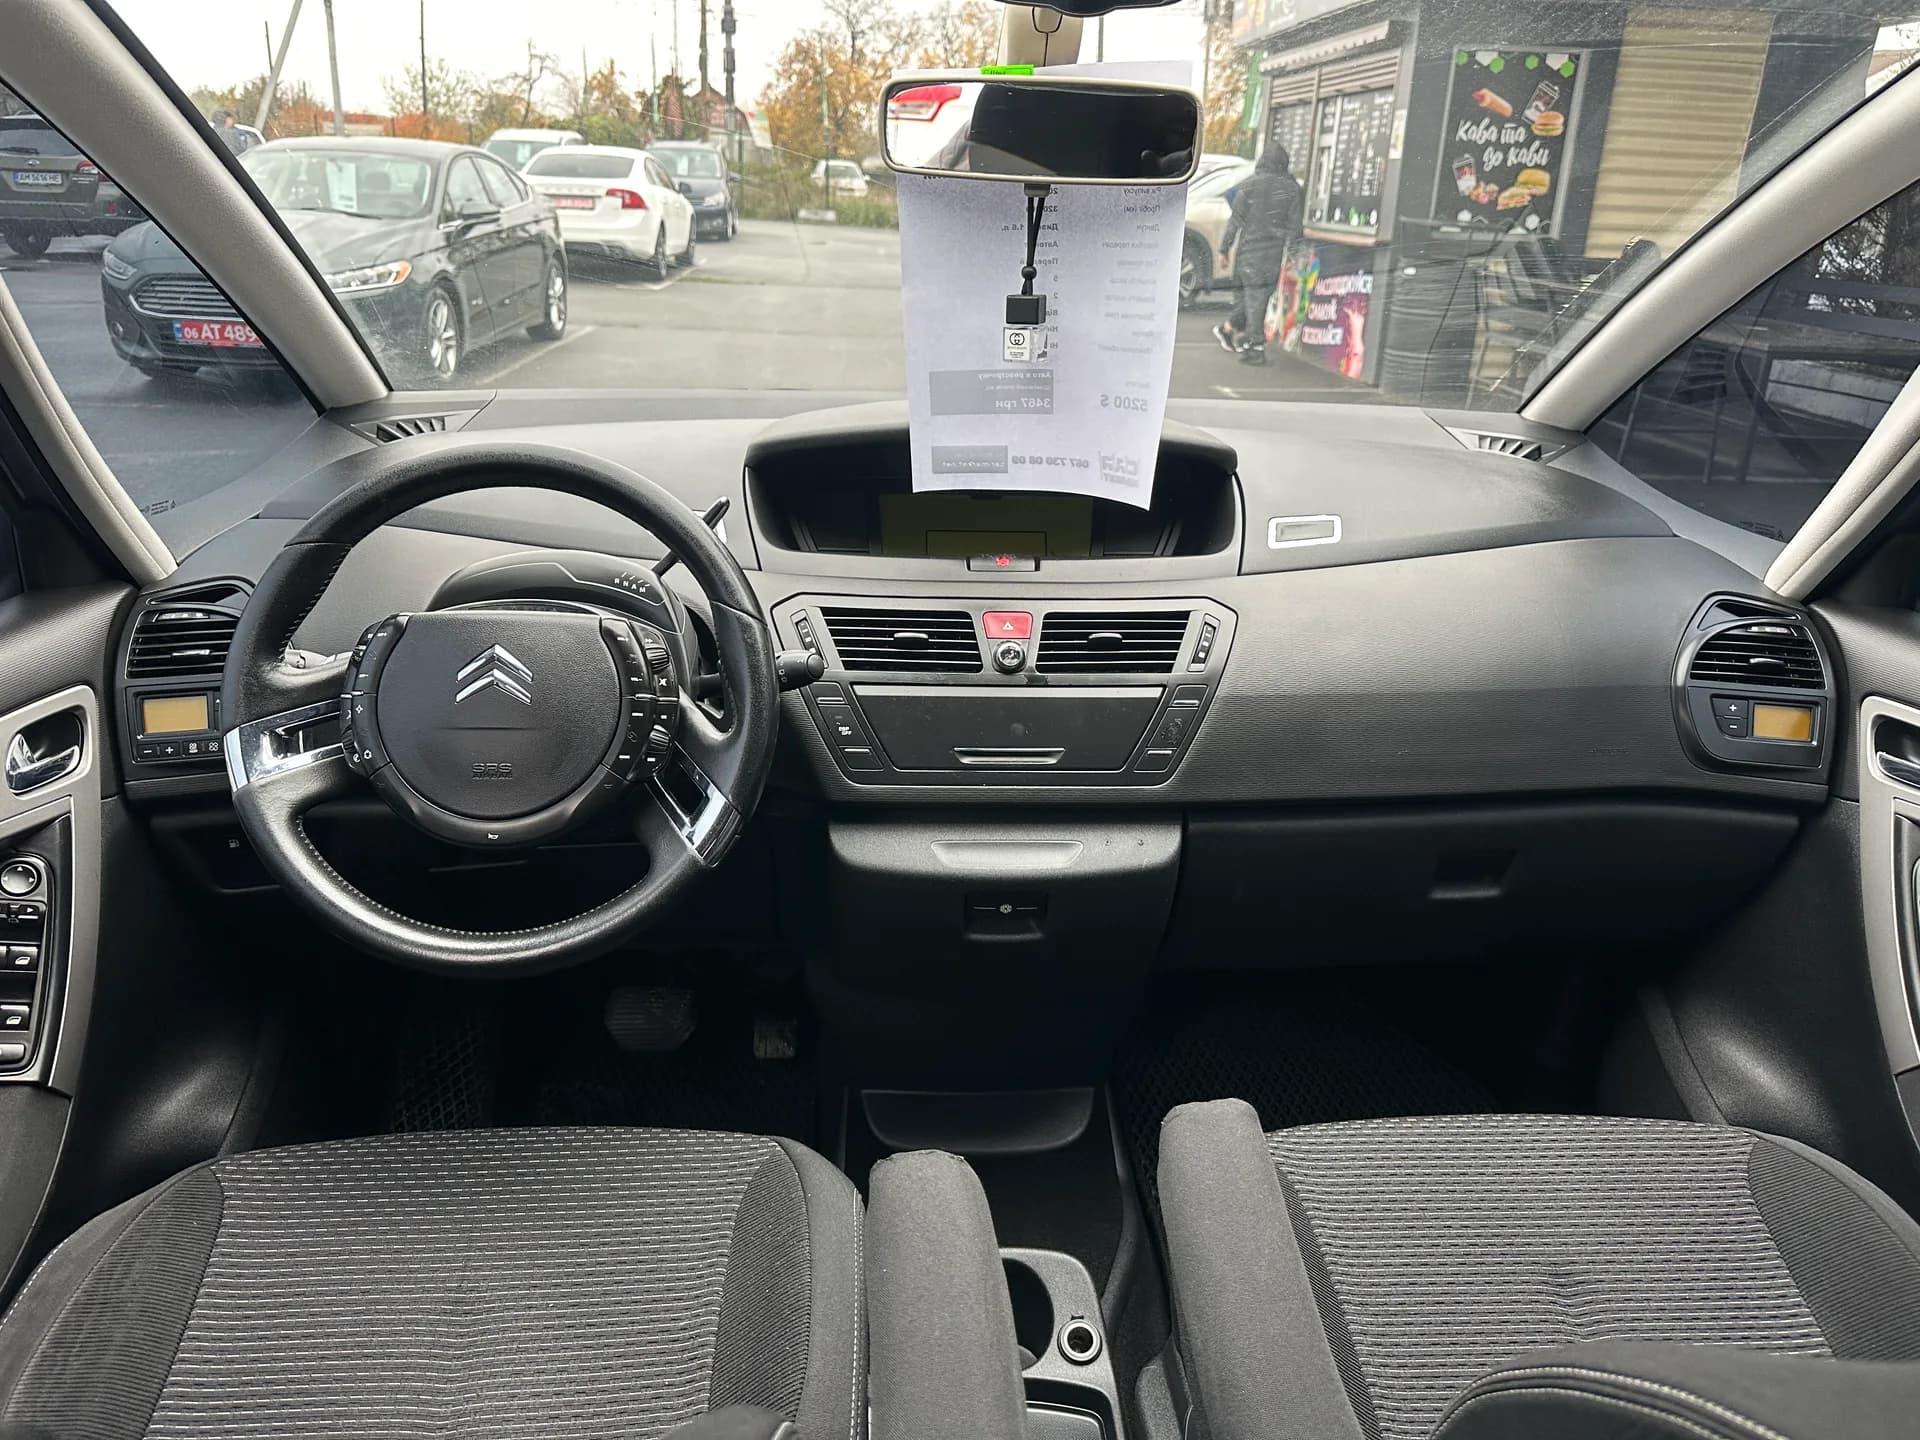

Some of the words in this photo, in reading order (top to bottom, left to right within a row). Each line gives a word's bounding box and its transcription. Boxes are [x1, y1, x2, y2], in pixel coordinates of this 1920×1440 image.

[1455, 117, 1499, 144] Кава
[1500, 123, 1527, 144] та
[1482, 146, 1504, 172] до
[183, 327, 199, 340] 06
[201, 323, 221, 340] AT
